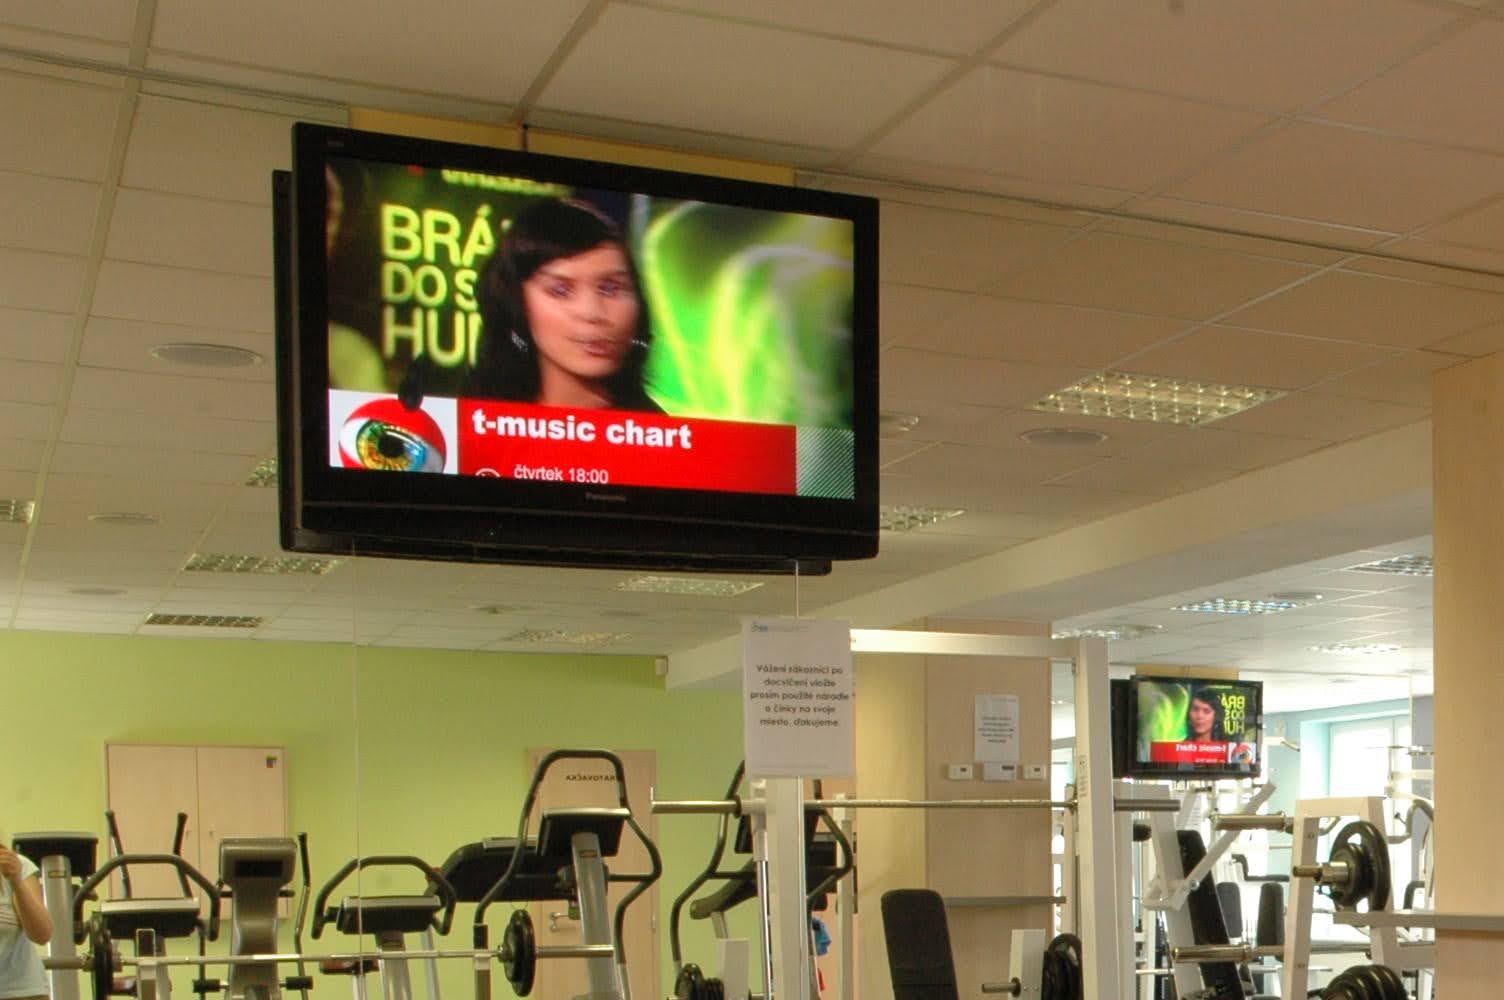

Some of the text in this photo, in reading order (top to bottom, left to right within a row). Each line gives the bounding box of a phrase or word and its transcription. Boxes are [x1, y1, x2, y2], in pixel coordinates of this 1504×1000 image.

[382, 261, 447, 307] DO
[472, 408, 692, 449] t-music chart
[513, 464, 609, 484] čtvrtek 18:00
[831, 667, 844, 675] po
[799, 705, 811, 713] na
